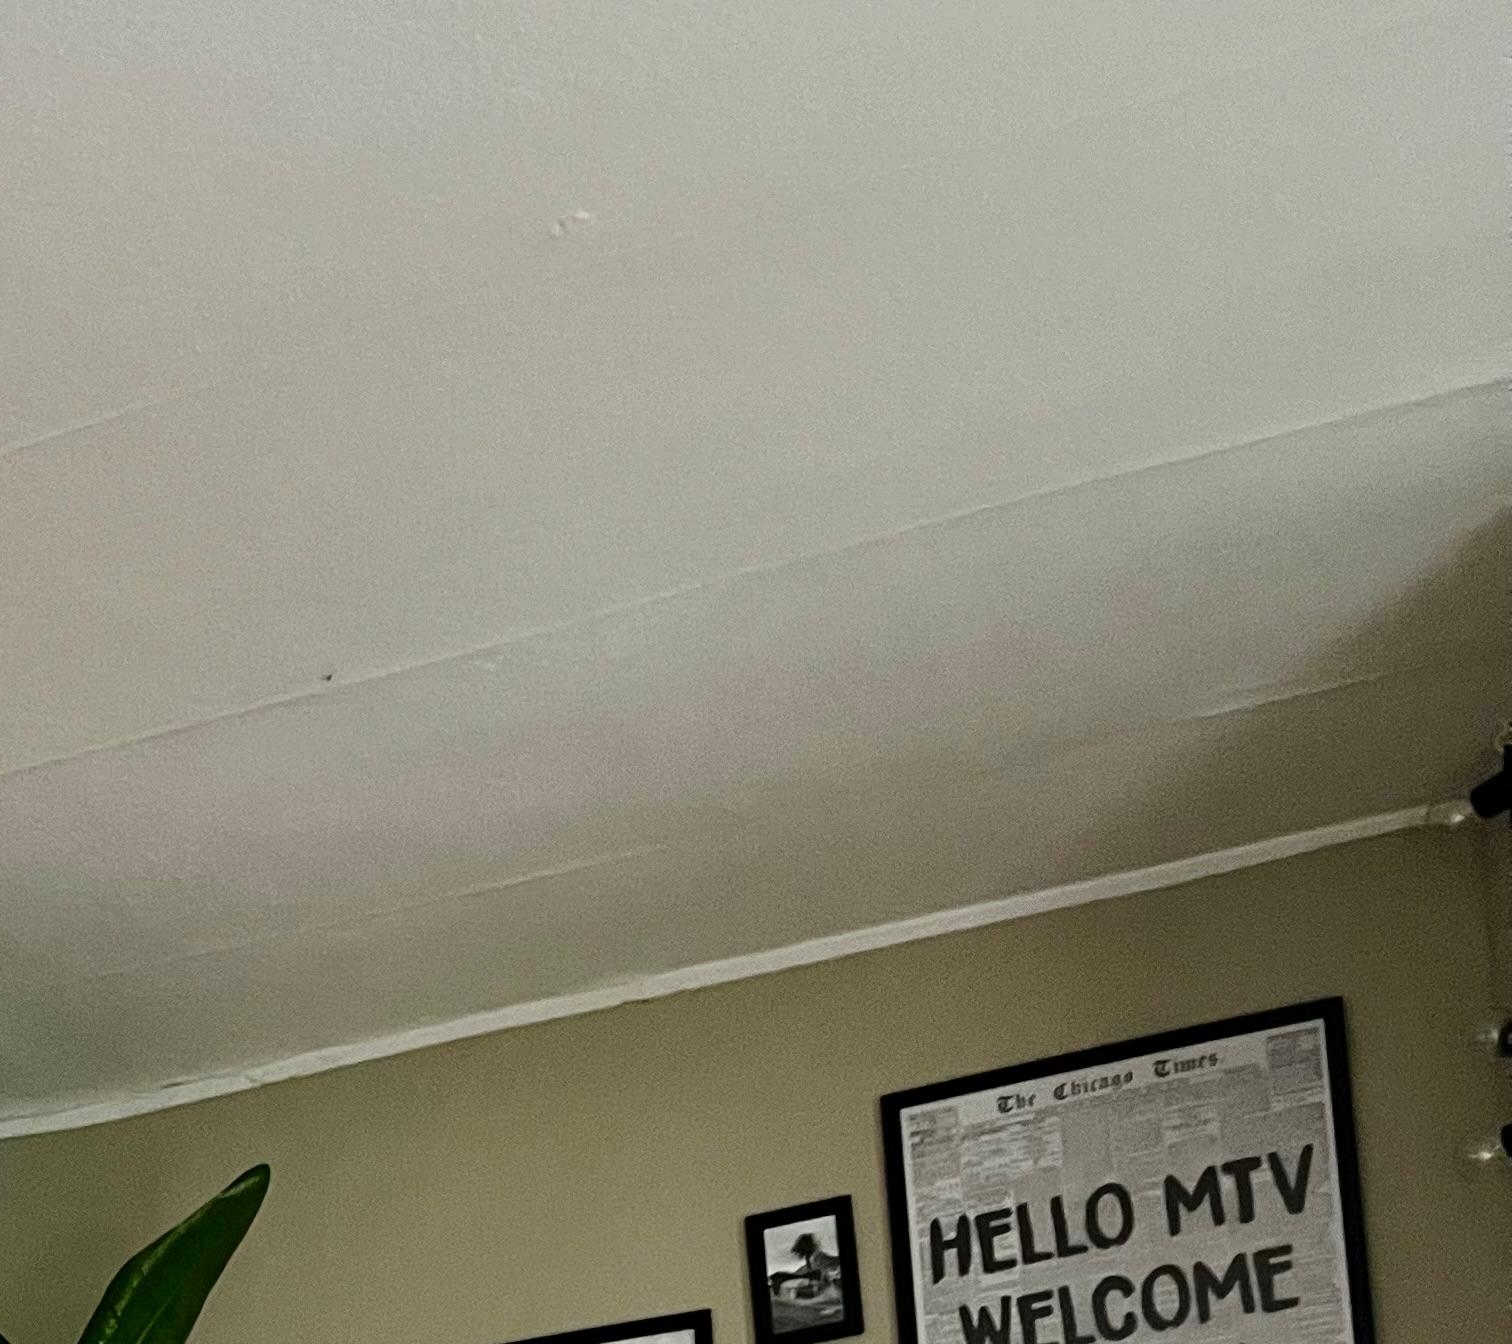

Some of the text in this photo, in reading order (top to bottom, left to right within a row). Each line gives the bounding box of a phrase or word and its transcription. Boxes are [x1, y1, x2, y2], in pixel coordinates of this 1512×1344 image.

[996, 1051, 1219, 1114] The Chicago Times
[929, 1143, 1315, 1286] HELLO MTV
